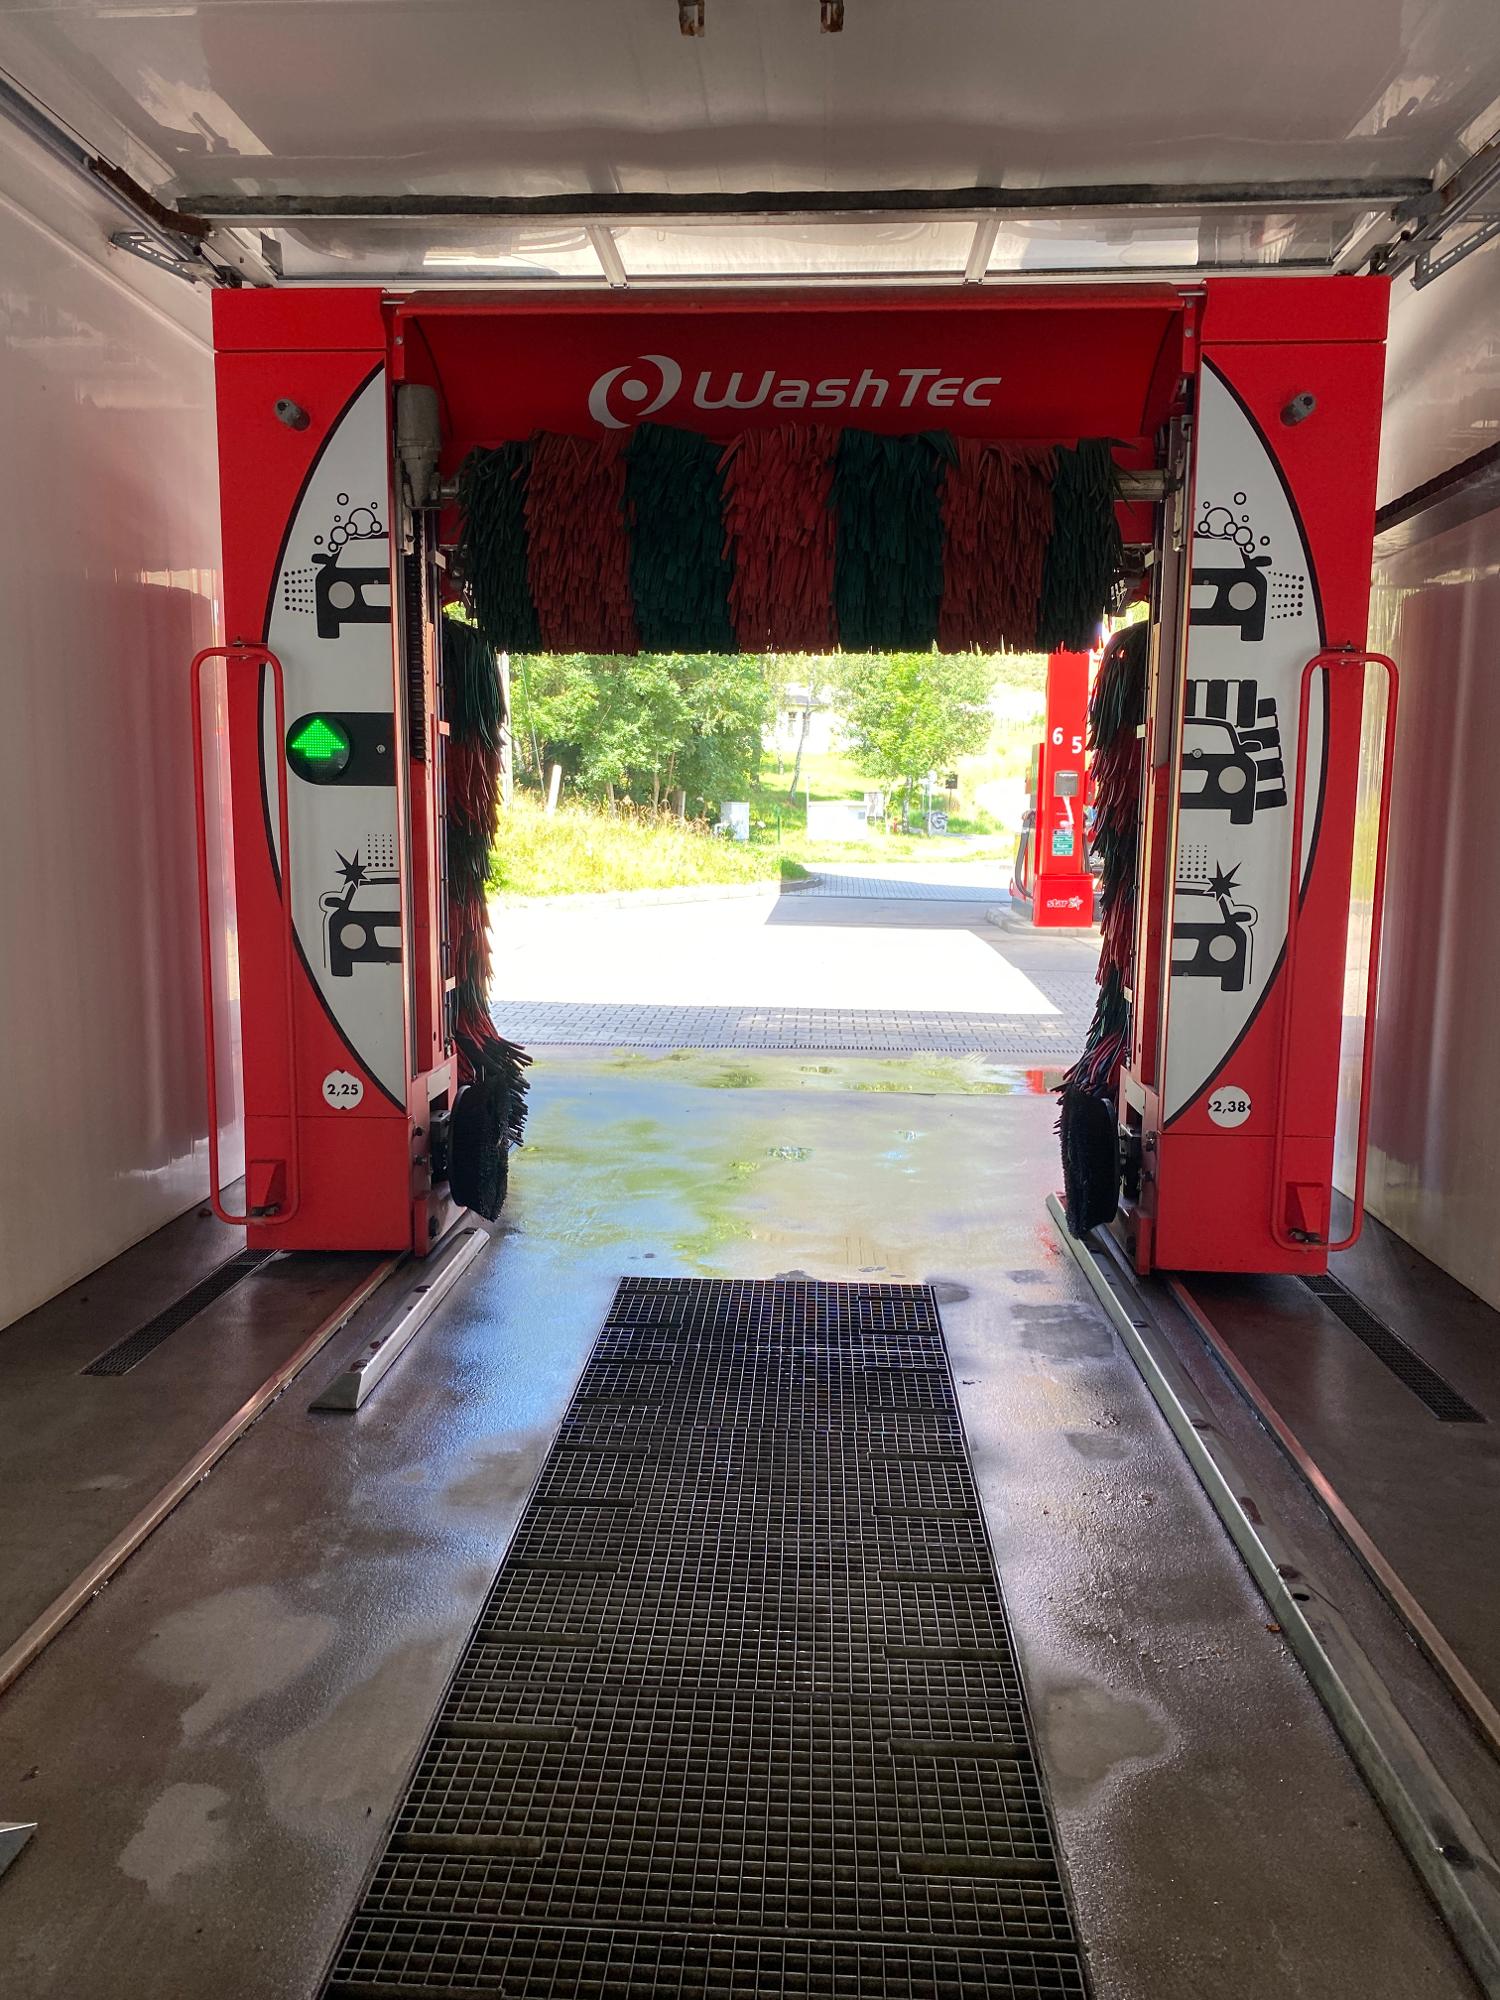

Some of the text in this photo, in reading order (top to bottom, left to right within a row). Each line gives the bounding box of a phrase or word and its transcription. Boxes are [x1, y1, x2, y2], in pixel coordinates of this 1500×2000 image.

[1052, 726, 1064, 745] 6
[1071, 735, 1082, 754] 5
[327, 1083, 359, 1097] 2,25
[1212, 1100, 1246, 1114] 2,38
